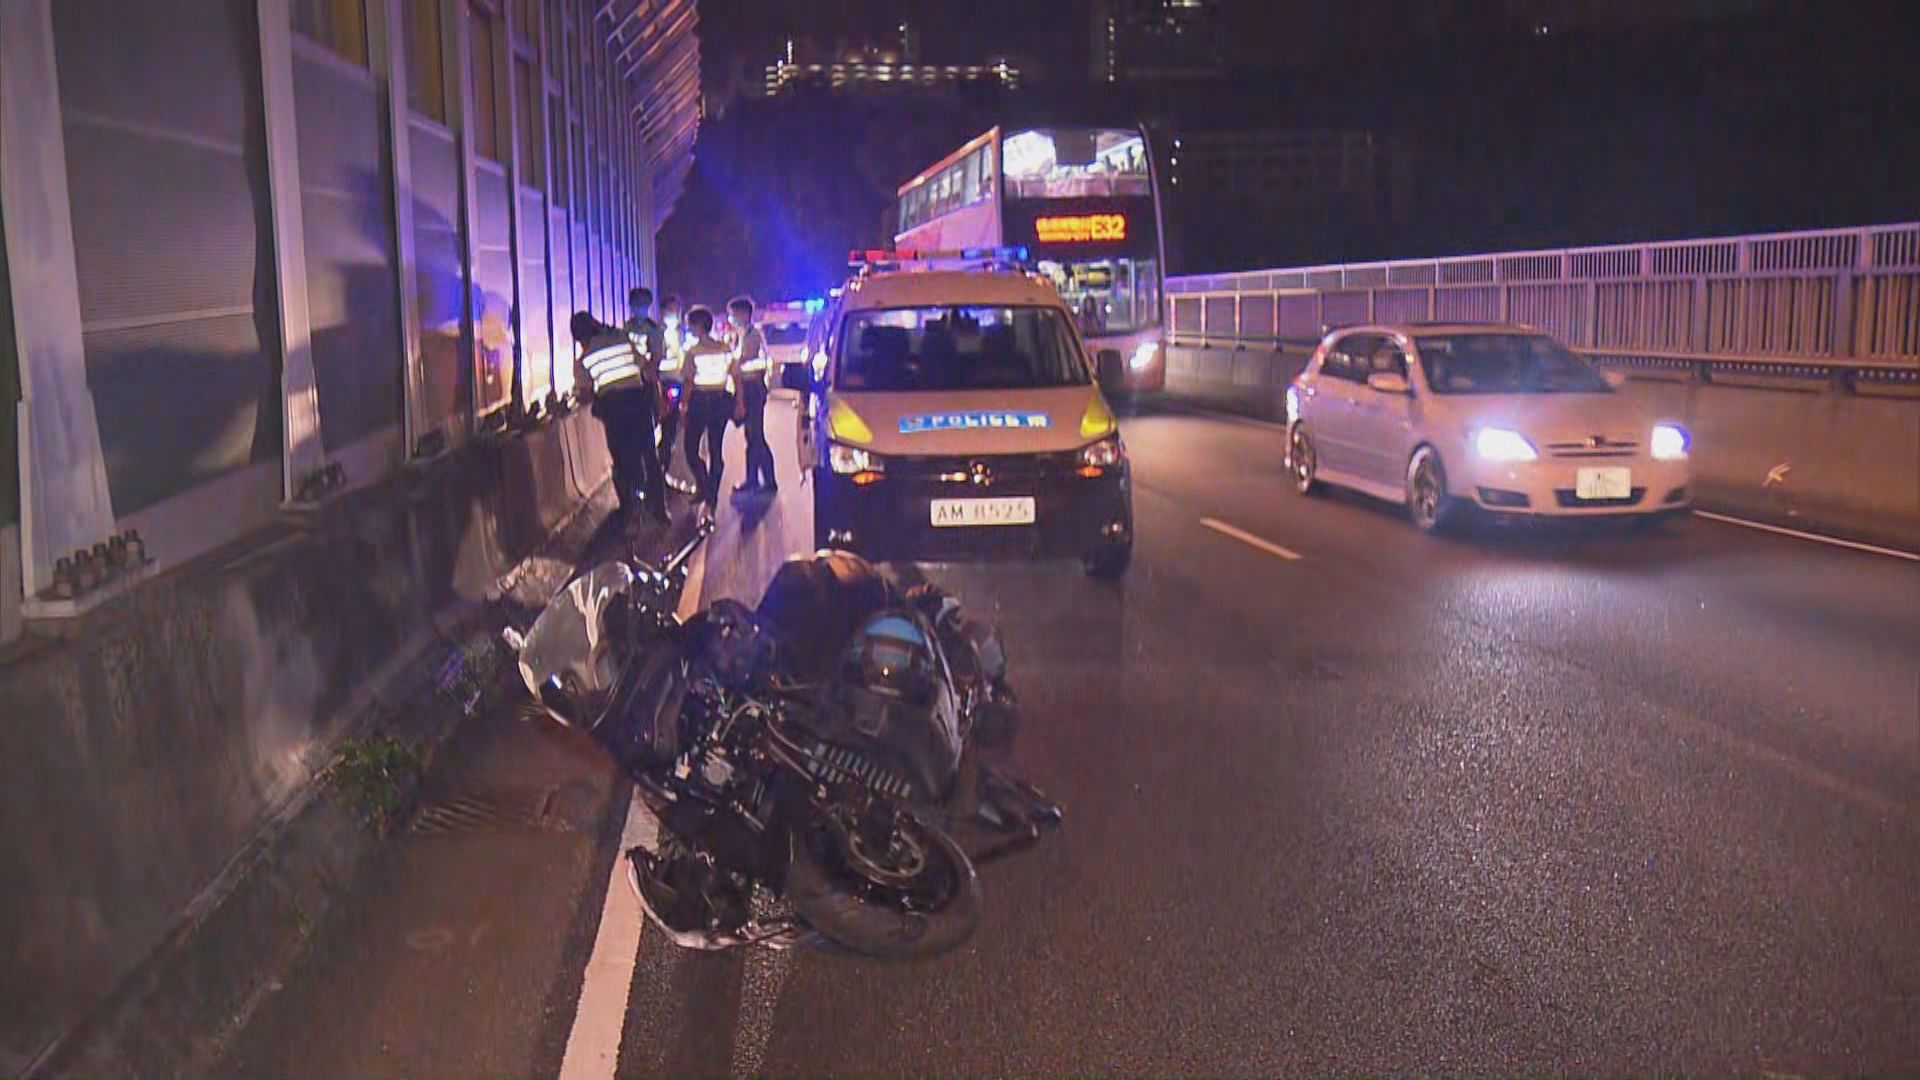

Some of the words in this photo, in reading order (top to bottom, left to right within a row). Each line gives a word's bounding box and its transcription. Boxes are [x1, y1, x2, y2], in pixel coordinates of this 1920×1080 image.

[1091, 214, 1125, 240] E32
[931, 413, 1021, 429] POLICE
[937, 504, 964, 521] AM
